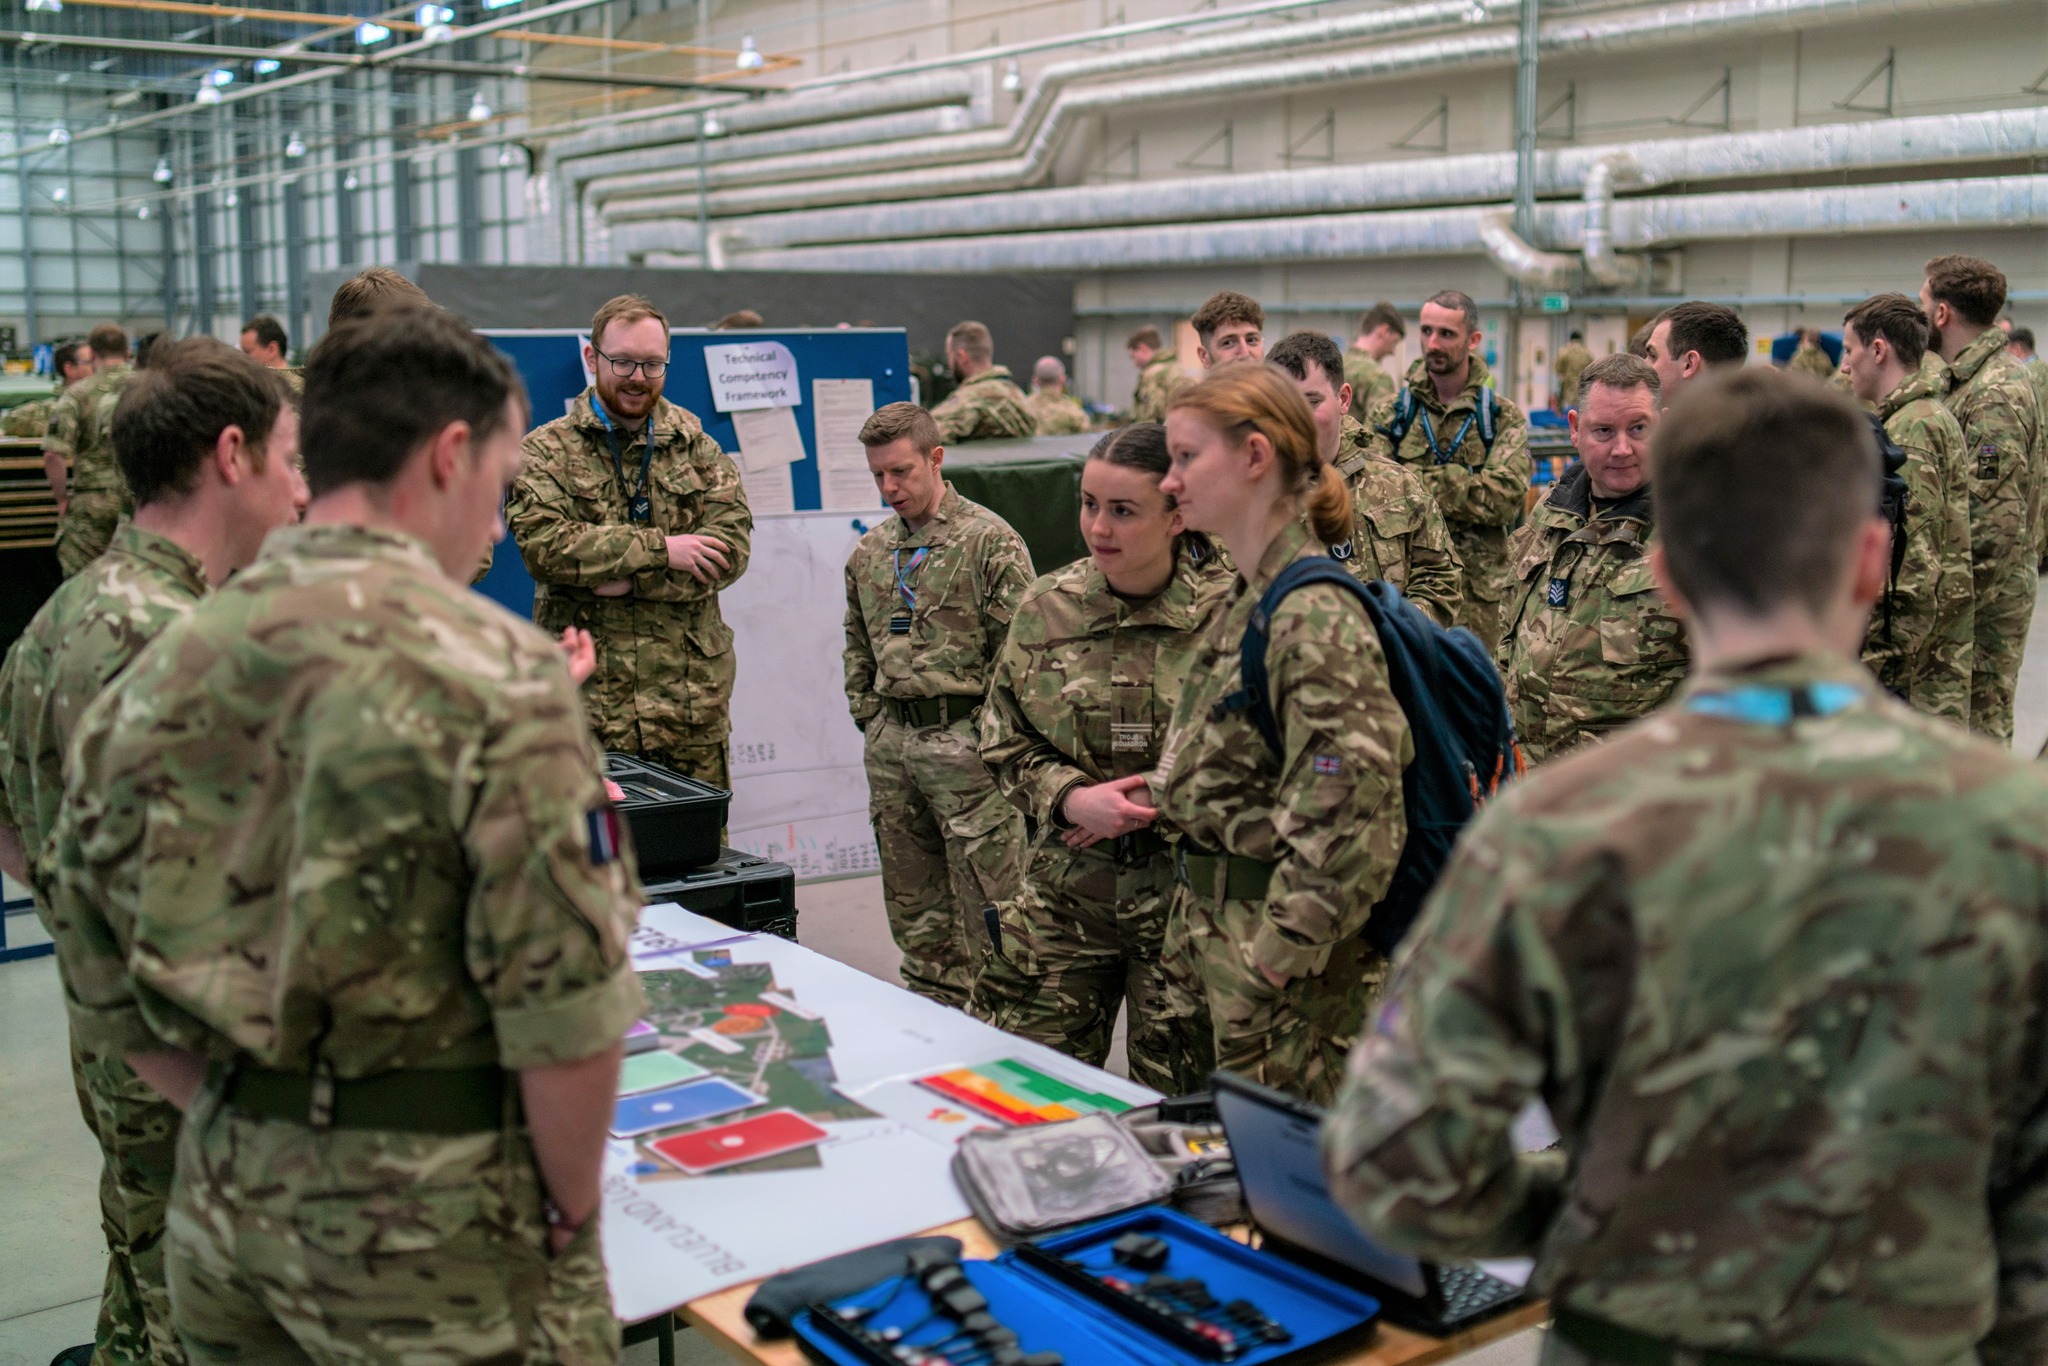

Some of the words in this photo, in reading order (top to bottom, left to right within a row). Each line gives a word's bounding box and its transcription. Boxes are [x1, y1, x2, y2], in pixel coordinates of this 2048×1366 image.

[724, 350, 776, 365] Technical
[719, 370, 788, 384] Competency
[725, 387, 786, 402] Framework
[623, 1200, 746, 1276] BLUELAND
